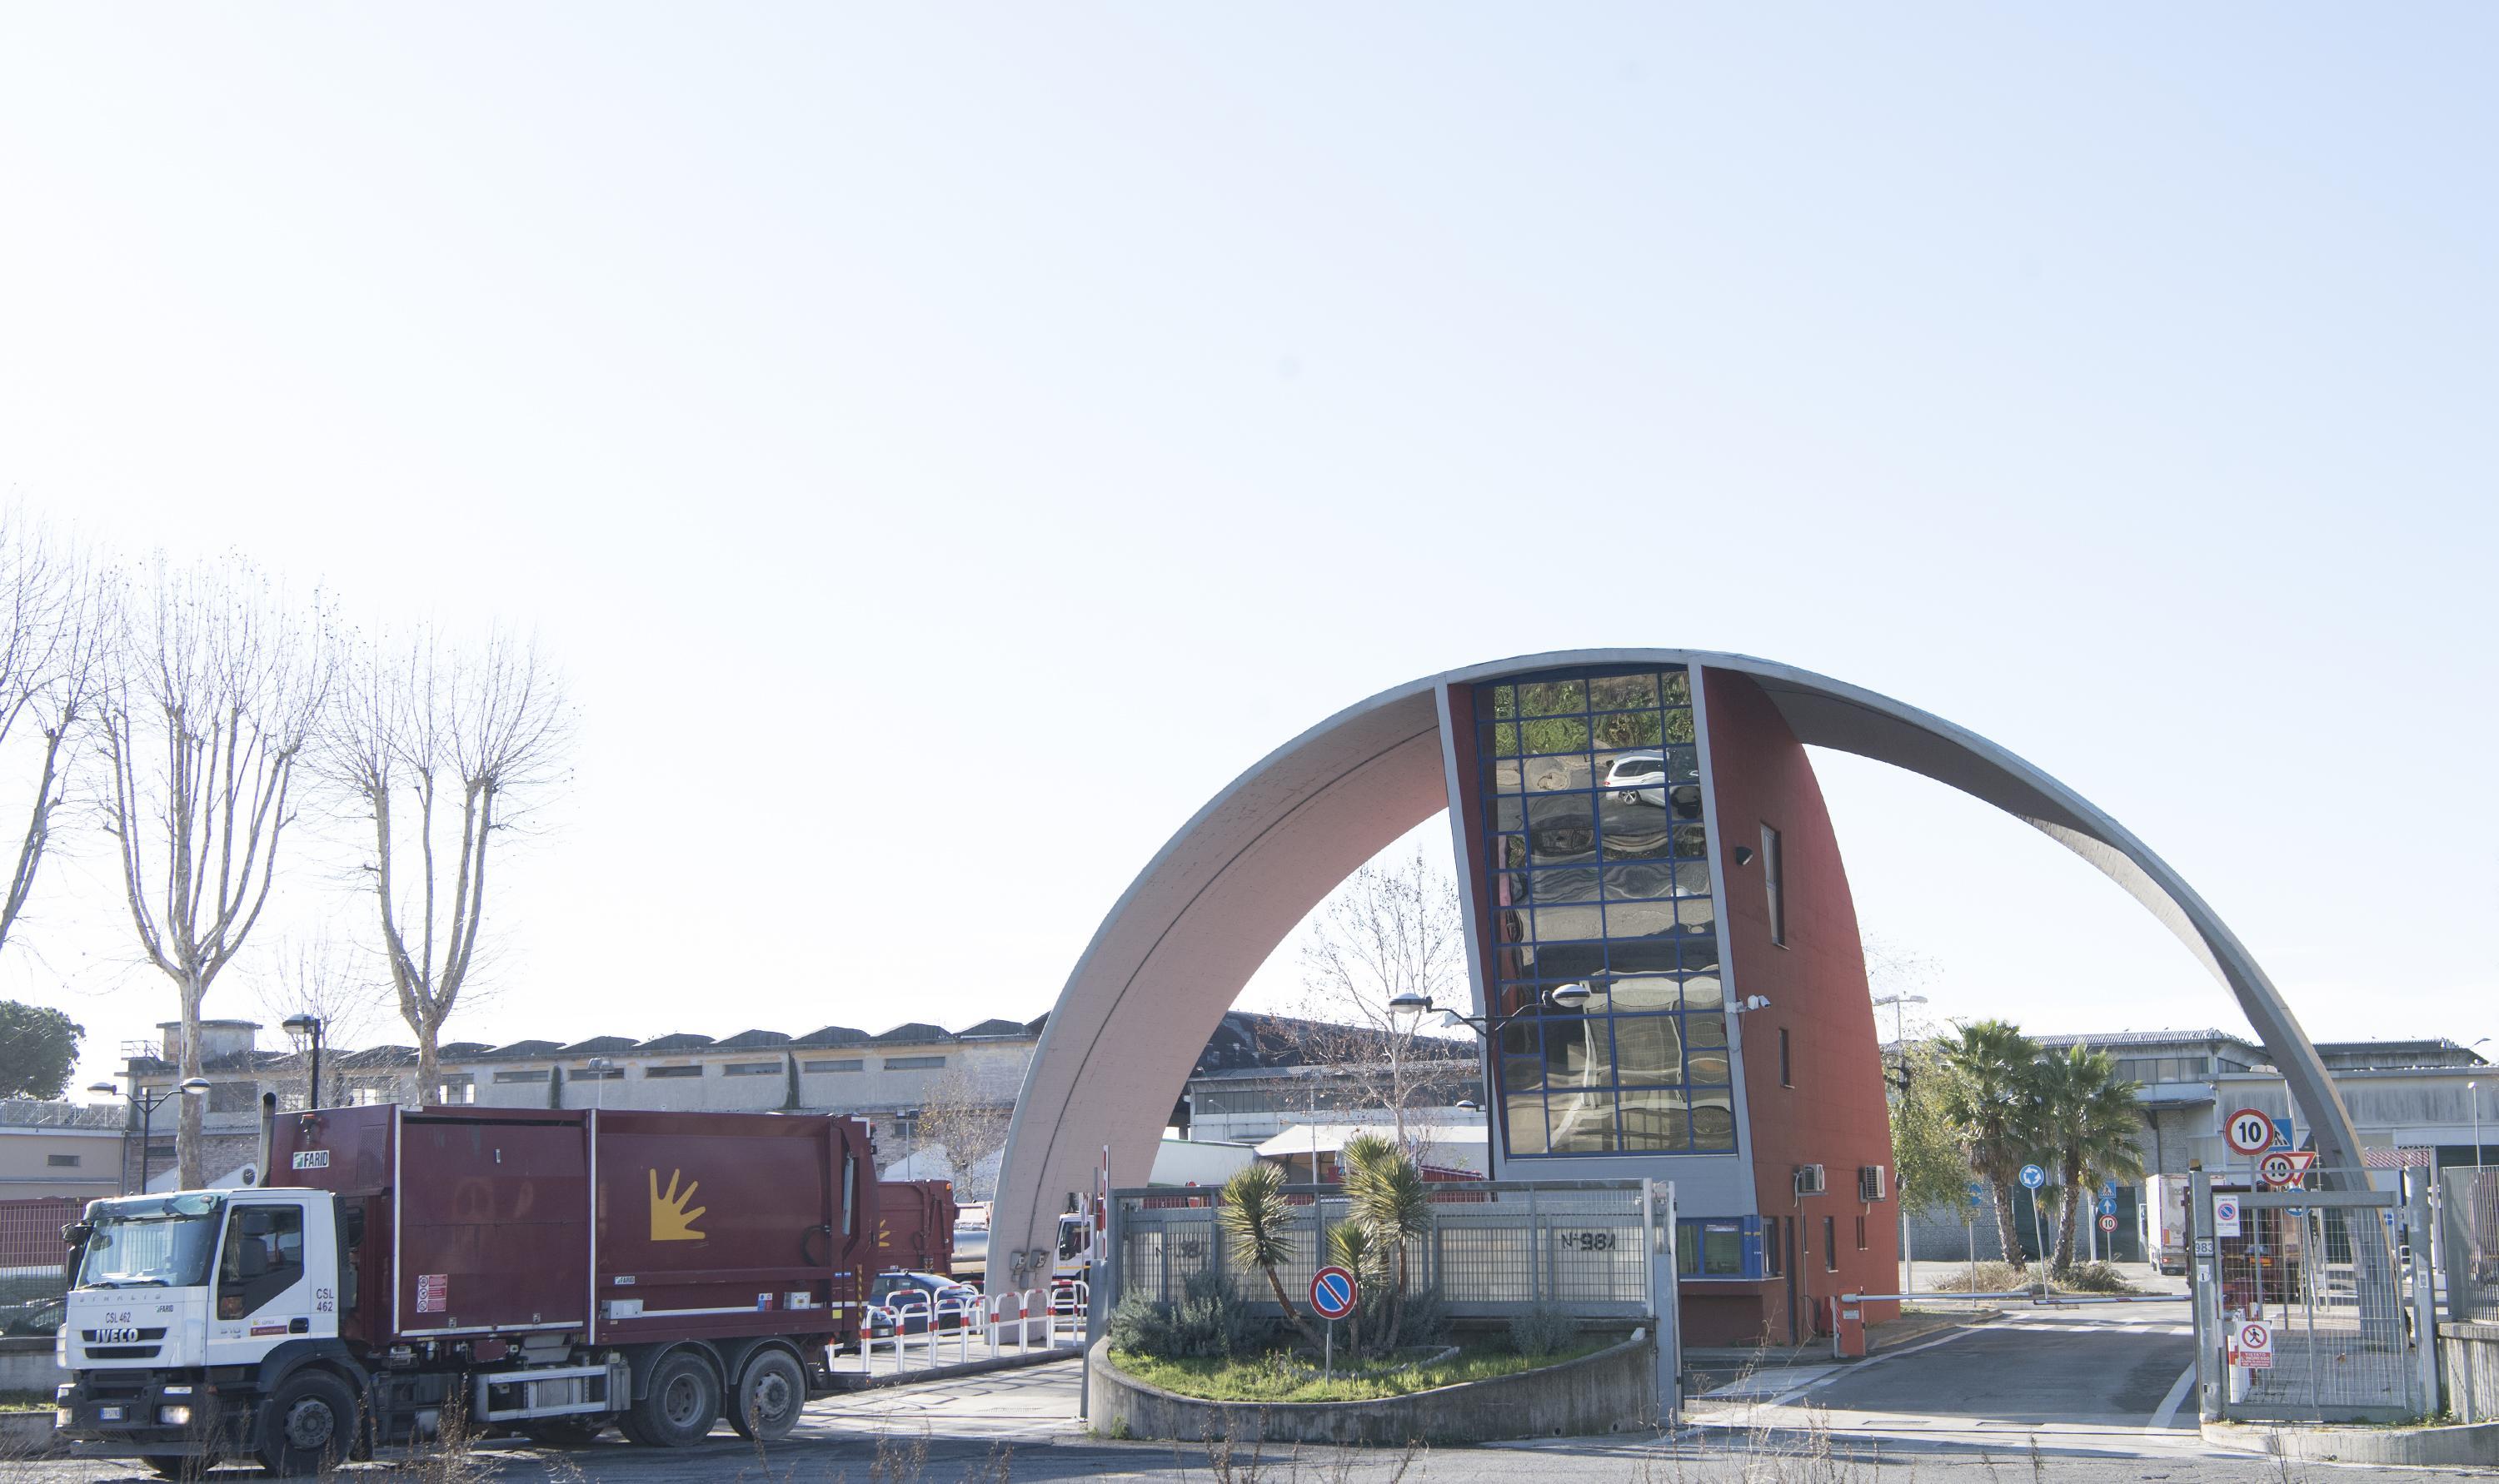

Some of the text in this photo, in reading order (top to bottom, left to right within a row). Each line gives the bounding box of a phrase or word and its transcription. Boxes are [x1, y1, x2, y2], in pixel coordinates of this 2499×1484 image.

[2239, 1122, 2262, 1143] 10
[304, 1152, 328, 1168] FARID
[2270, 1162, 2287, 1177] 10
[2104, 1219, 2113, 1228] 10
[2195, 1242, 2213, 1252] 983
[317, 1288, 334, 1299] CSL
[317, 1301, 333, 1312] 462
[106, 1312, 131, 1323] CSL 462
[96, 1328, 138, 1343] IVECO
